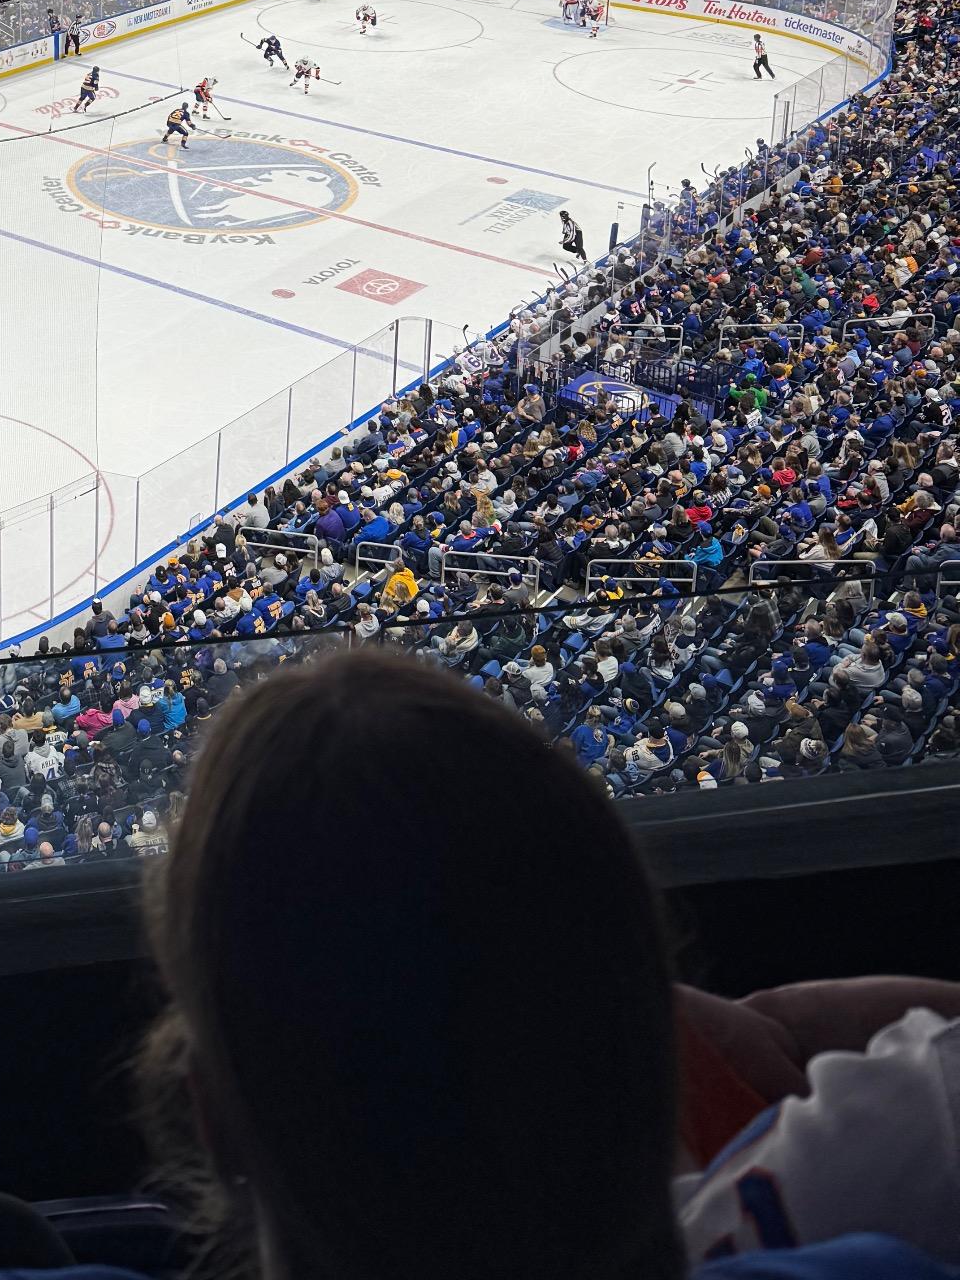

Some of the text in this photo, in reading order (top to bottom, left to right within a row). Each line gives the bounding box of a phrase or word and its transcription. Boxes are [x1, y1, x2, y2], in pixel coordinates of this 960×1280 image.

[704, 0, 776, 27] Tim Hortons
[784, 17, 844, 46] ticketmaster
[328, 152, 382, 188] Center
[42, 176, 276, 246] KeyBank Center
[303, 258, 361, 286] TOYOTA
